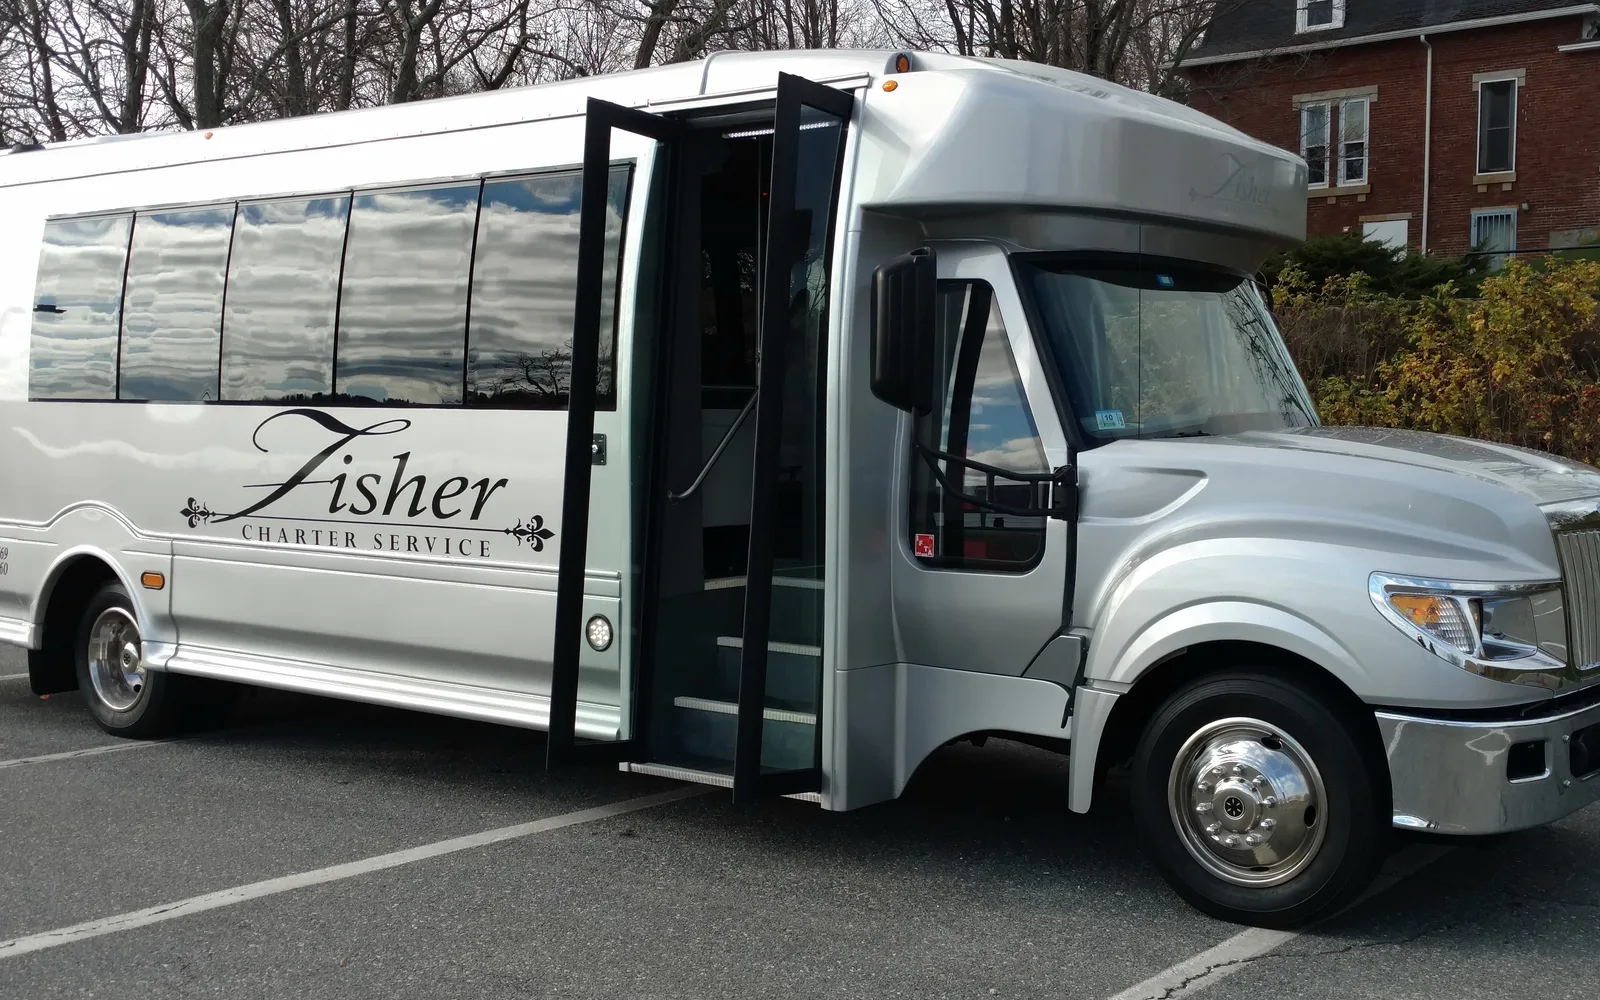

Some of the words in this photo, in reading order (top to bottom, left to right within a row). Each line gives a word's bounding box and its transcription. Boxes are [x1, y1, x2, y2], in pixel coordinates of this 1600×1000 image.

[211, 408, 509, 524] Fisher
[241, 523, 357, 548] CHARTER
[373, 533, 492, 558] SERVICE
